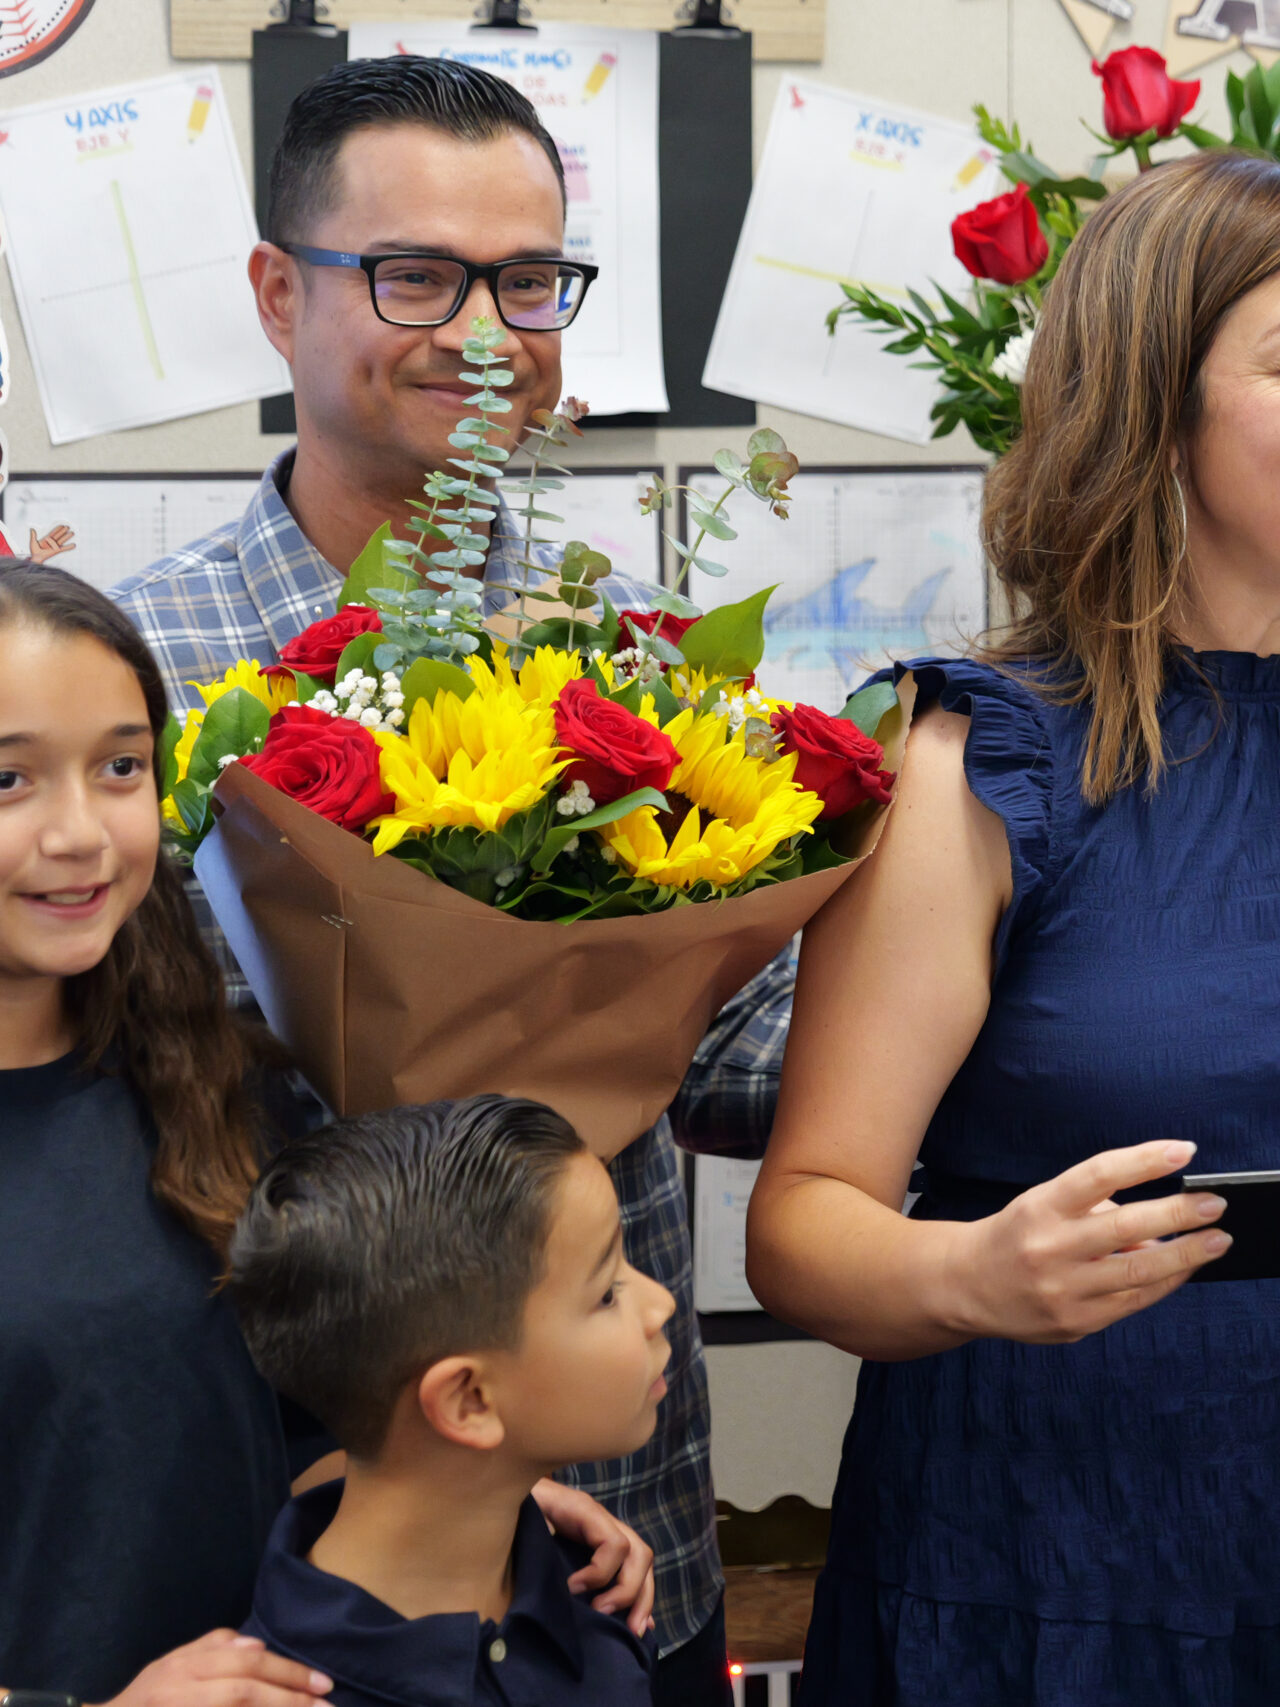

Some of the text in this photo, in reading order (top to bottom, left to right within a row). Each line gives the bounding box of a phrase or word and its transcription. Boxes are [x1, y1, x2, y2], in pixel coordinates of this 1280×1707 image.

[88, 99, 139, 128] AXIS
[856, 113, 924, 147] X AXIS
